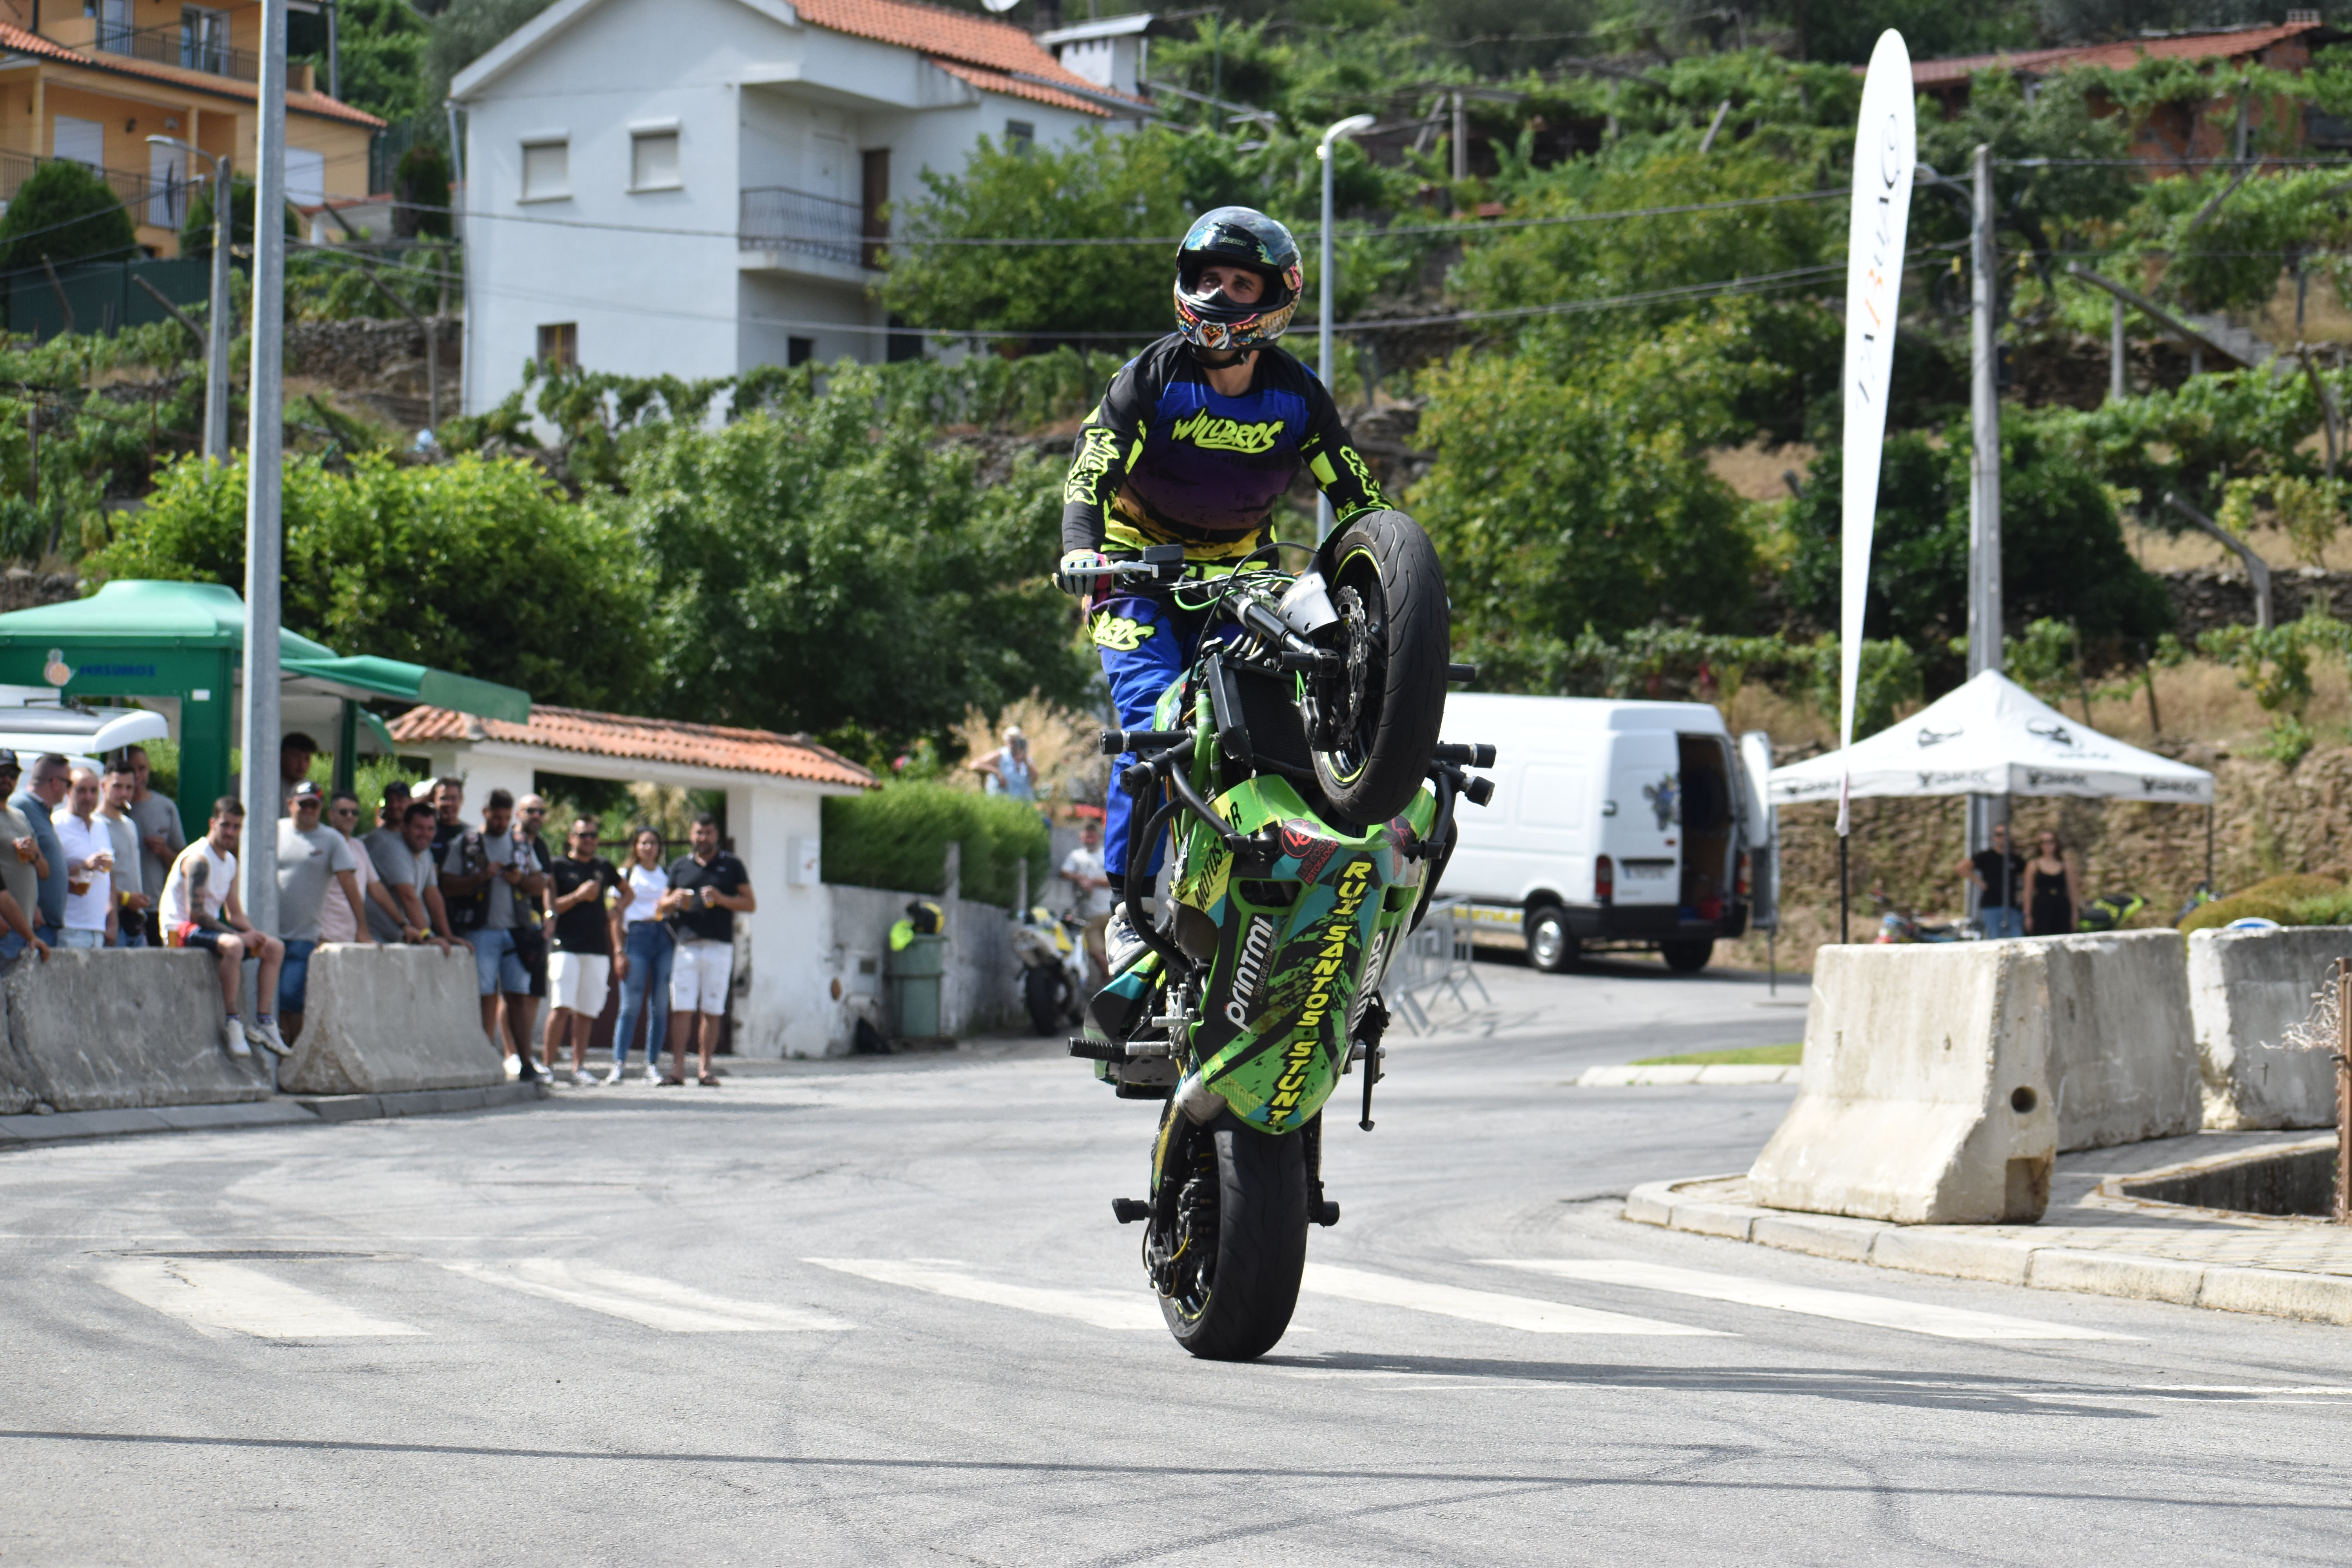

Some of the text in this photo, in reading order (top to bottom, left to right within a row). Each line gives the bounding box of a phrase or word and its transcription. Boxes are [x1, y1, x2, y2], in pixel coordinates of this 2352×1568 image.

[1172, 407, 1284, 454] WILLBROS
[1195, 801, 1242, 911] MOTOSR
[1305, 840, 1338, 884] ESTOFADOR
[1269, 861, 1372, 1125] RUI SANTOS STUNT
